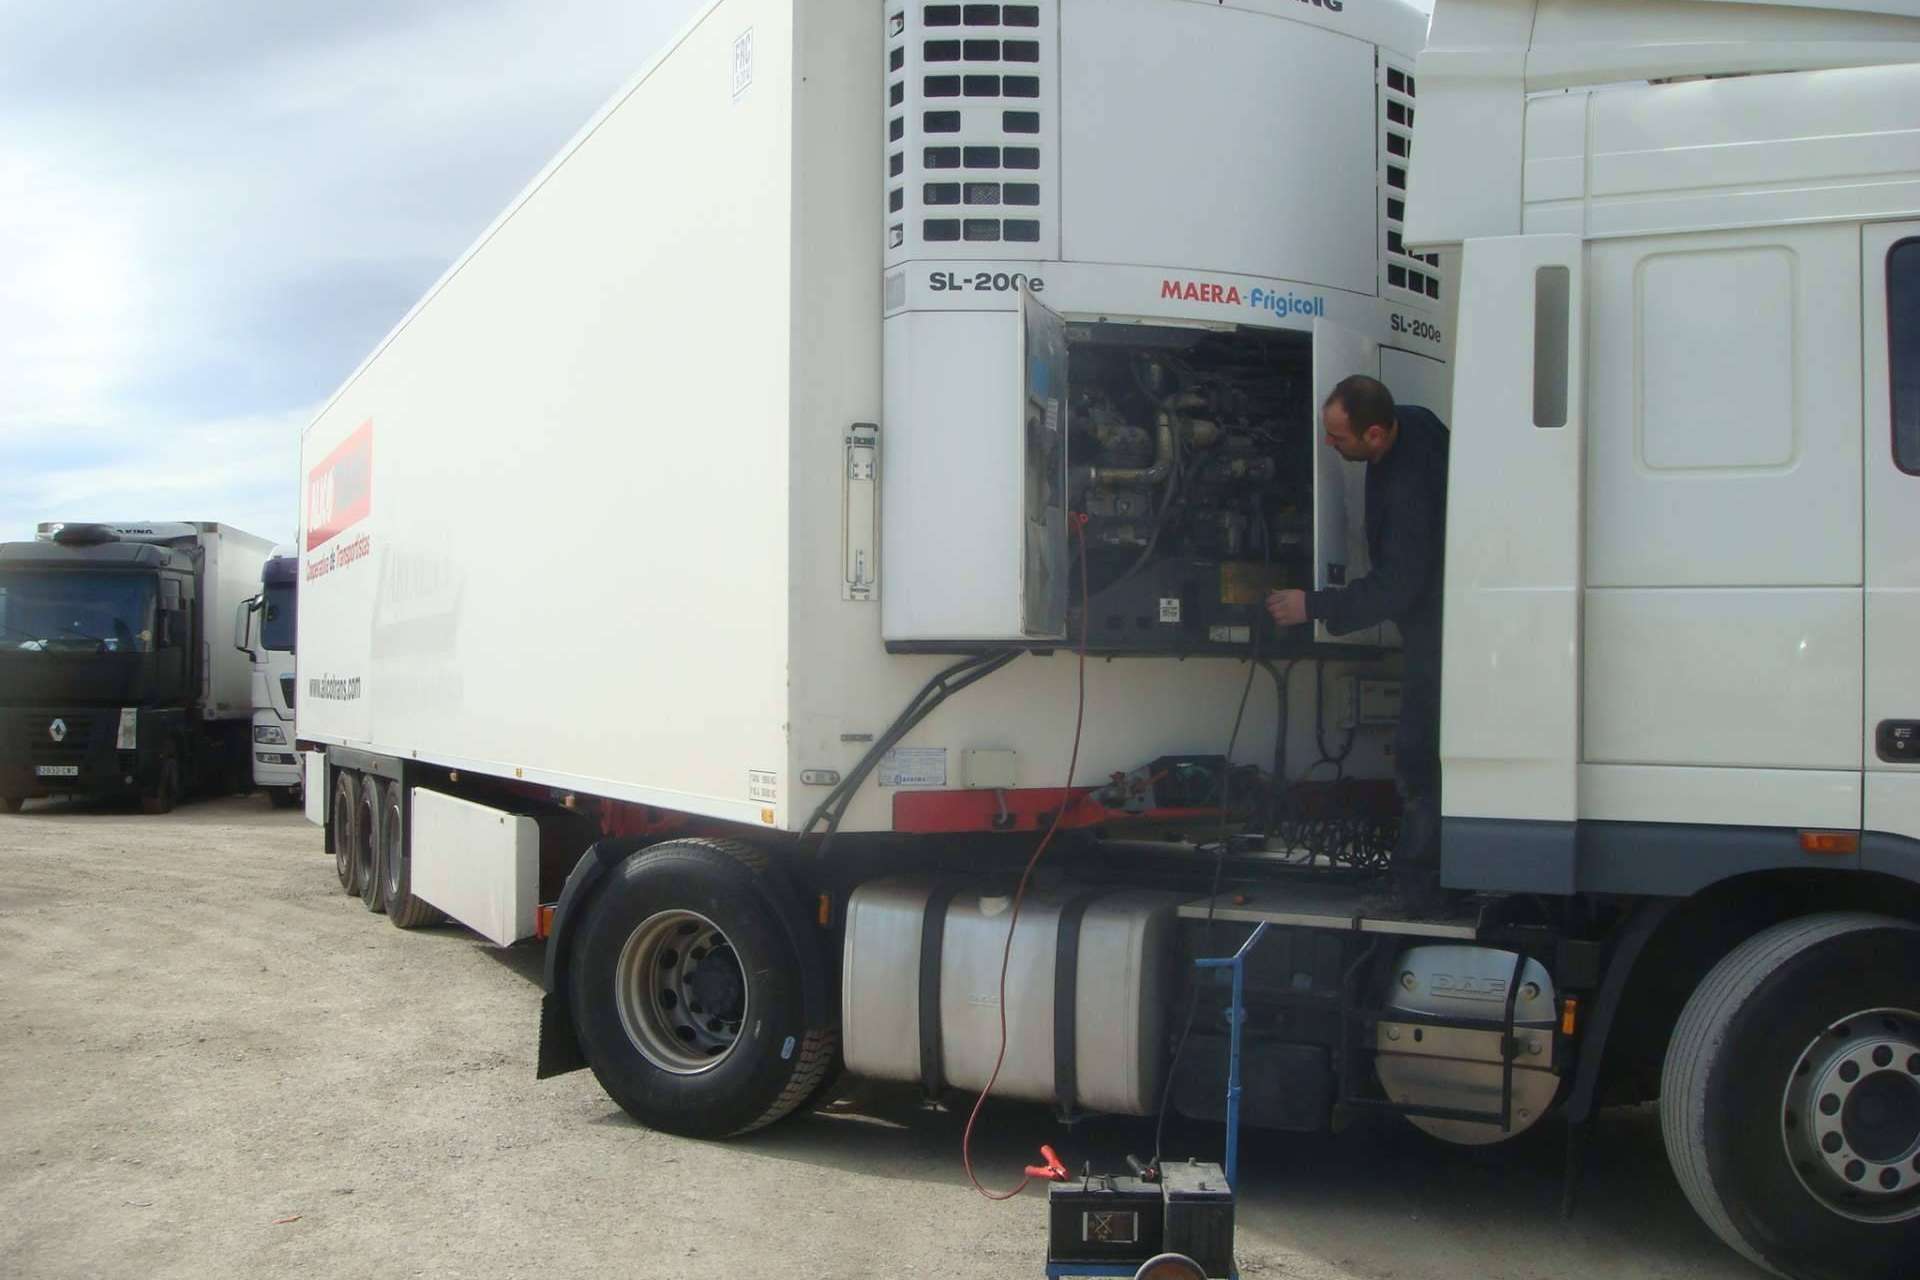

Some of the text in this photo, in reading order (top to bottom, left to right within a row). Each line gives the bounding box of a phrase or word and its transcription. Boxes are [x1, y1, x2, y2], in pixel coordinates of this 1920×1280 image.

[929, 272, 1045, 292] SL-200e
[1391, 313, 1441, 343] SL-200e
[329, 549, 336, 572] de
